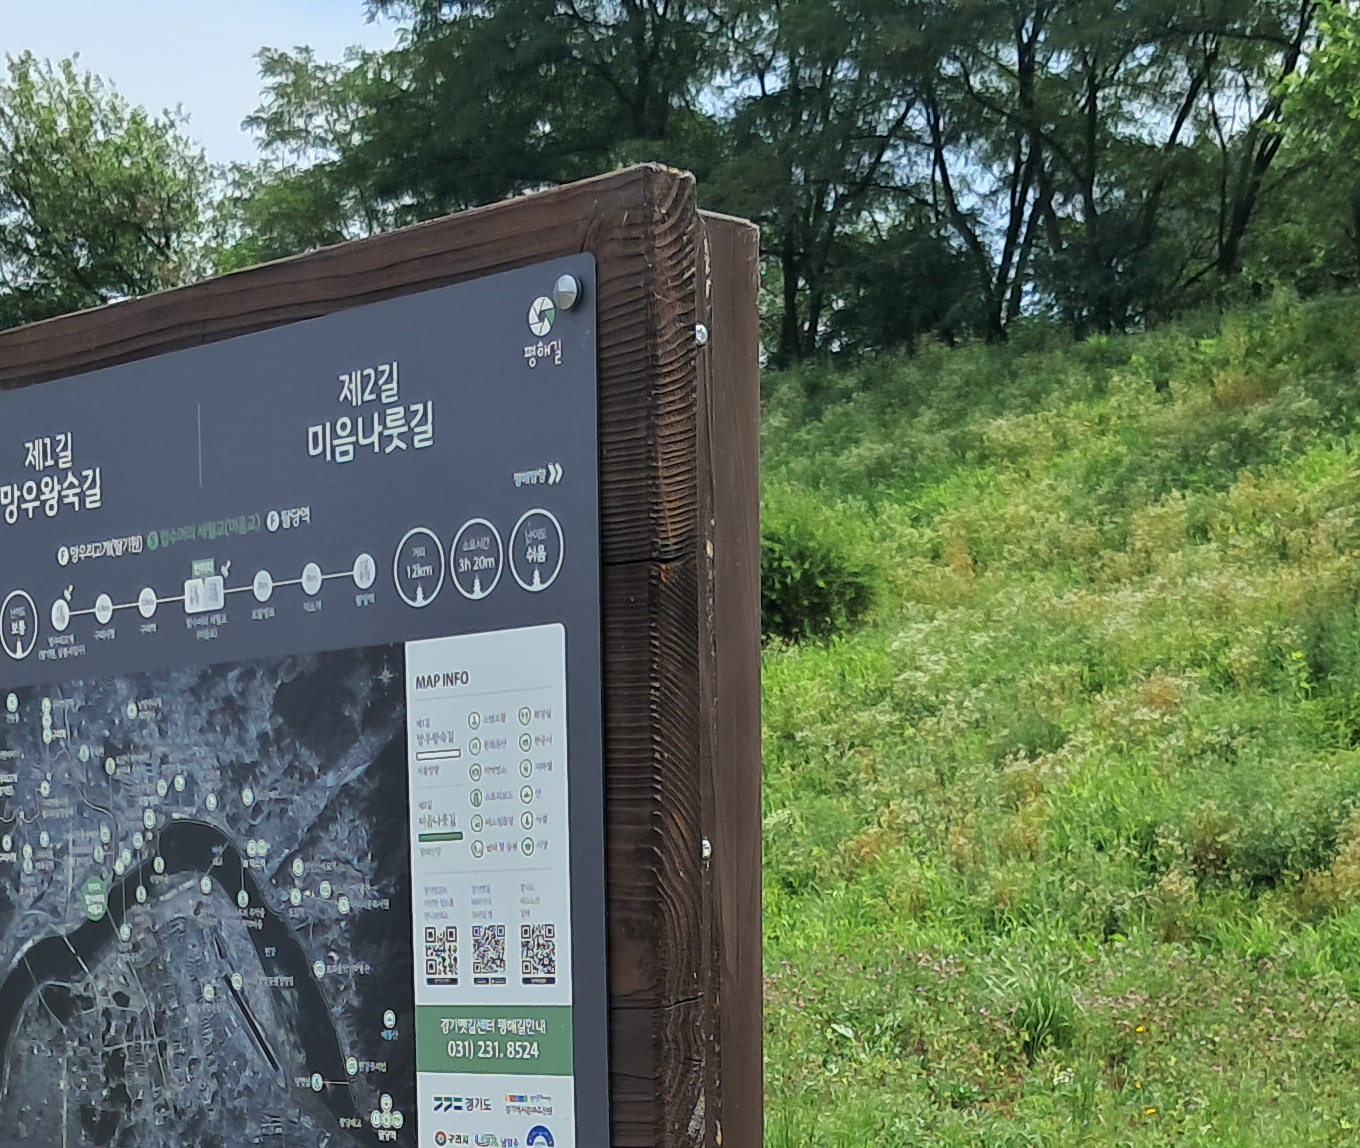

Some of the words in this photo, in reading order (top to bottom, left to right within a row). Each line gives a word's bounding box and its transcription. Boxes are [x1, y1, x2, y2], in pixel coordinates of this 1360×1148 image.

[523, 339, 563, 368] 평해길
[338, 361, 399, 406] 제2길
[307, 400, 434, 463] 미음나룻길
[24, 432, 72, 471] 제1길
[0, 467, 102, 525] 망우왕숙길
[281, 506, 311, 529] 팔당역
[526, 544, 547, 564] 쉬움
[406, 564, 433, 580] 12km
[458, 558, 471, 573] 3h
[473, 556, 496, 572] 20m
[10, 619, 27, 637] 보통
[416, 674, 440, 690] MAP
[442, 670, 469, 688] INFO
[440, 1017, 495, 1036] 경기옛길센터
[497, 1017, 547, 1035] 평해길안내
[447, 1040, 474, 1060] 031)
[477, 1041, 504, 1059] 231.
[506, 1041, 539, 1059] 8524
[465, 1097, 492, 1112] 경기도
[448, 1132, 469, 1145] 구리시
